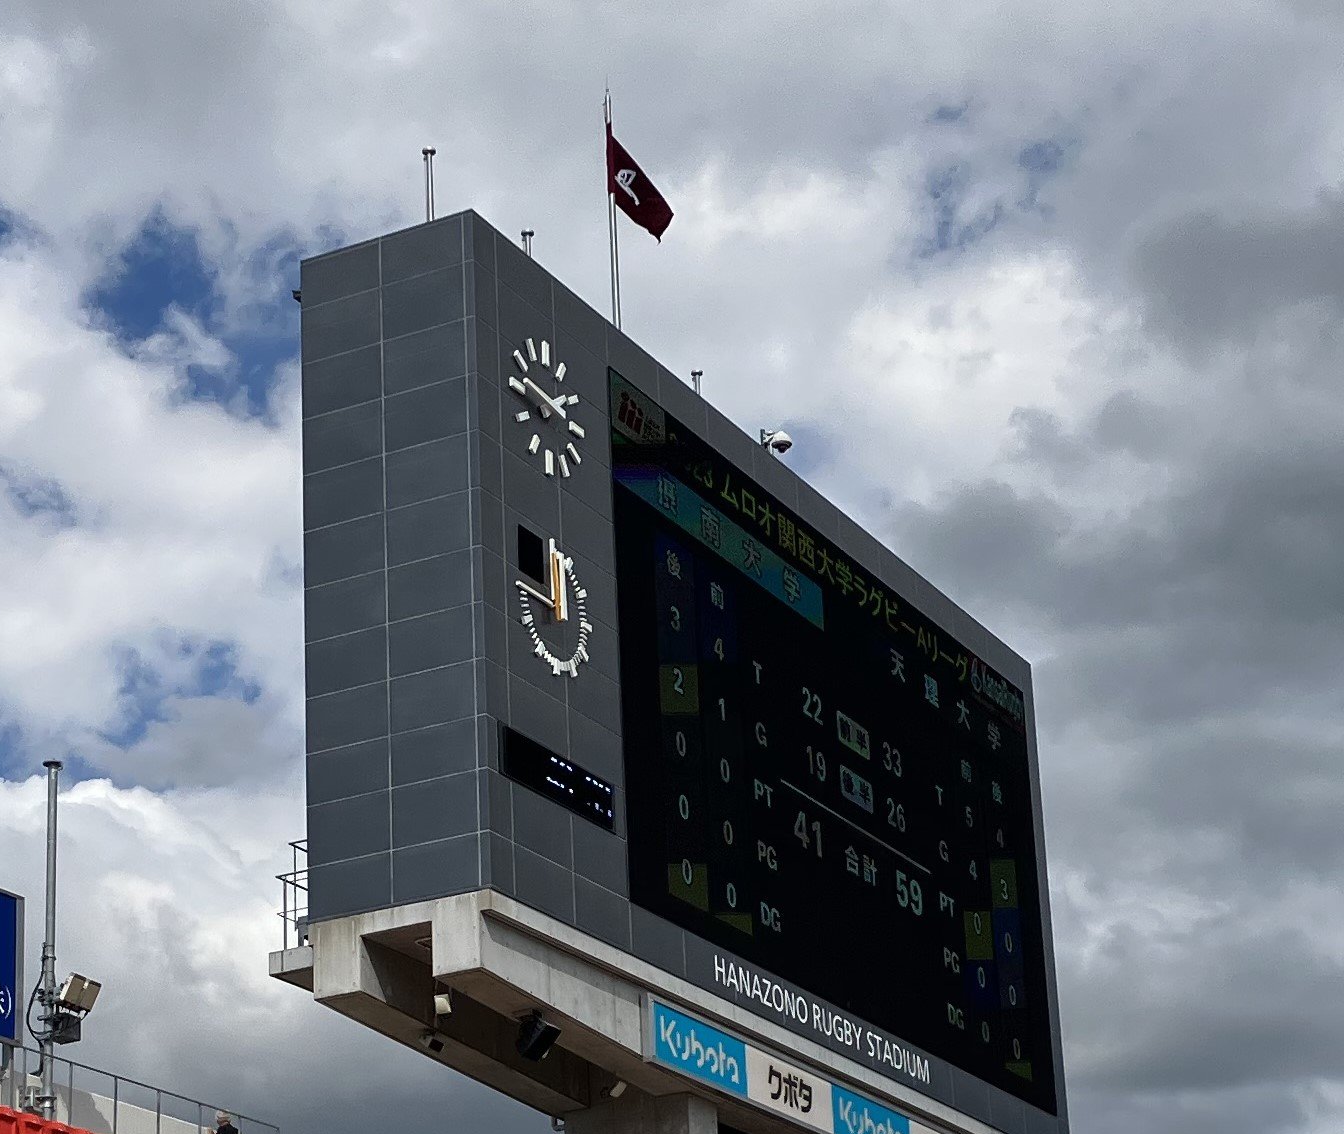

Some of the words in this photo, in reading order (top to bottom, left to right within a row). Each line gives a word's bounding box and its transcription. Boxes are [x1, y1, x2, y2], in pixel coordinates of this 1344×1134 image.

[752, 660, 763, 685] T
[673, 667, 685, 695] 2
[718, 698, 726, 722] 1
[756, 721, 768, 748] G
[801, 686, 824, 726] 22
[675, 731, 686, 757] 0
[720, 757, 730, 783] 0
[754, 777, 774, 809] PT
[806, 745, 827, 782] 19
[882, 741, 903, 778] 33
[678, 794, 689, 820] 0
[723, 819, 734, 845] 0
[757, 839, 778, 871] PG
[793, 810, 823, 859] 41
[886, 797, 906, 833] 26
[938, 839, 950, 863] G
[682, 858, 693, 885] 0
[726, 882, 737, 908] 0
[759, 901, 781, 933] DG
[895, 869, 923, 917] 59
[939, 890, 955, 918] PT
[973, 912, 982, 935] 0
[1005, 932, 1013, 953] 0
[943, 946, 960, 975] PG
[976, 966, 986, 989] 0
[1008, 984, 1017, 1006] 0
[714, 953, 808, 1025] HANAZONO
[813, 1003, 862, 1052] RUGBY
[867, 1030, 932, 1085] STADIUM
[946, 1002, 965, 1030] DG
[982, 1021, 990, 1043] 0
[1012, 1037, 1021, 1060] 0
[659, 1014, 741, 1085] Kubota
[767, 1064, 813, 1114] クボタ
